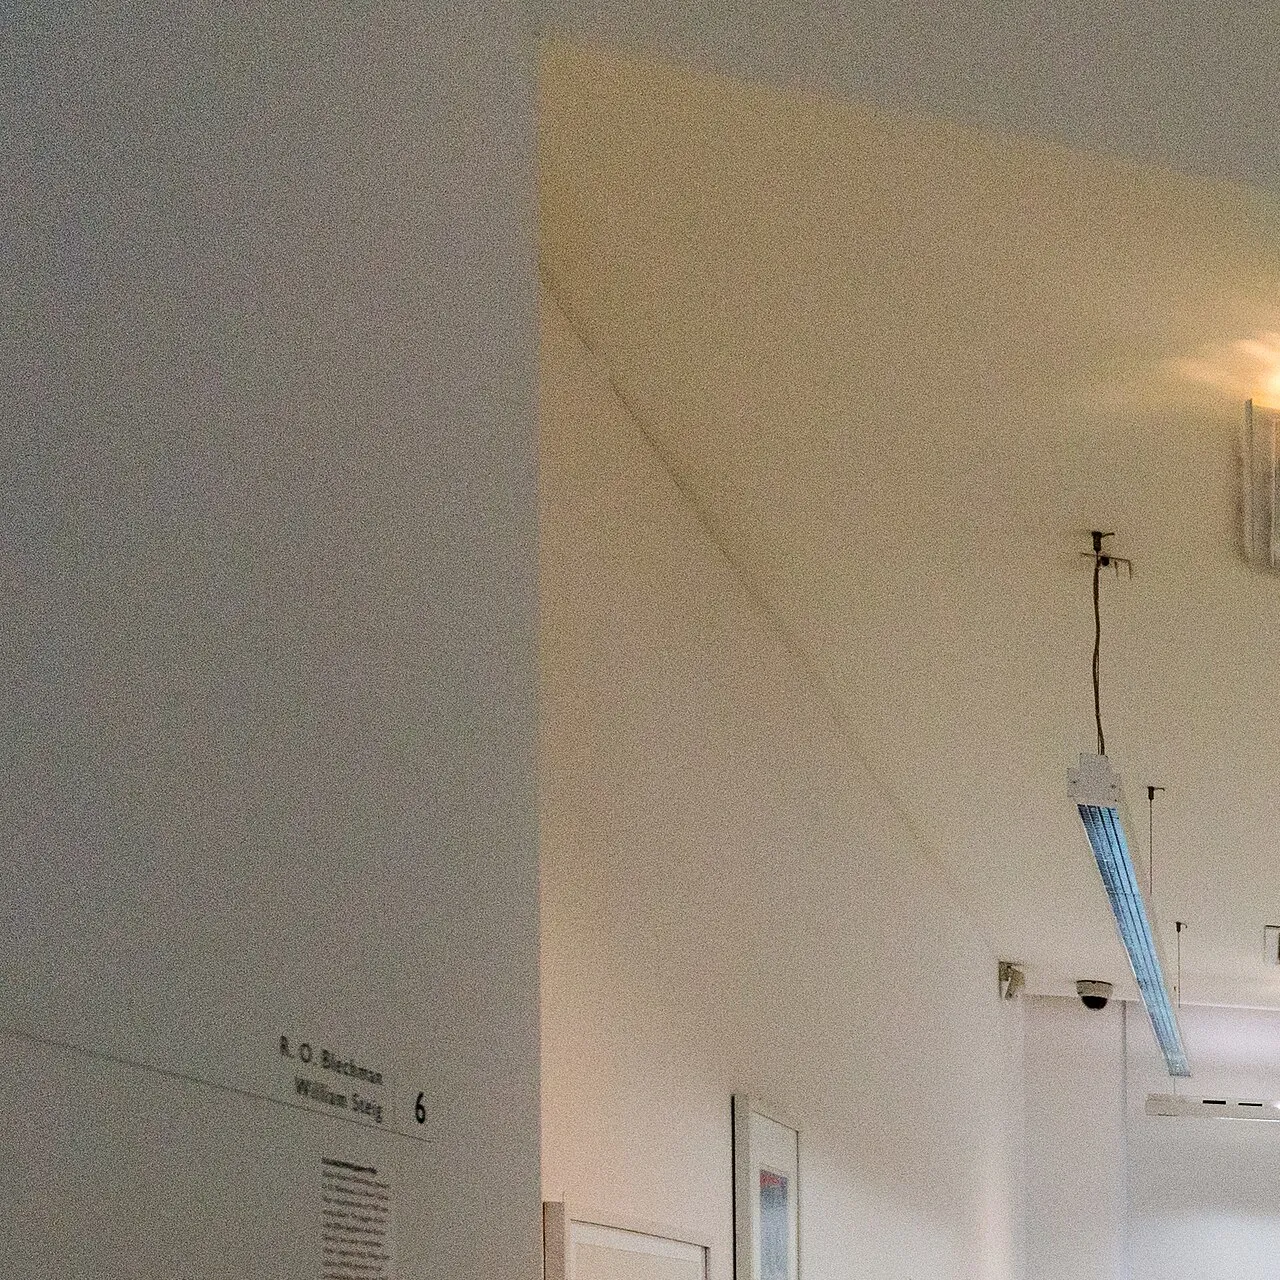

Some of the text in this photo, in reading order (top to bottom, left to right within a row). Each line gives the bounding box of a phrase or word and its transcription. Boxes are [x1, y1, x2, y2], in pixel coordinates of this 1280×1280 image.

[321, 1048, 384, 1085] Blechman
[294, 1075, 347, 1108] William
[415, 1091, 427, 1124] 6
